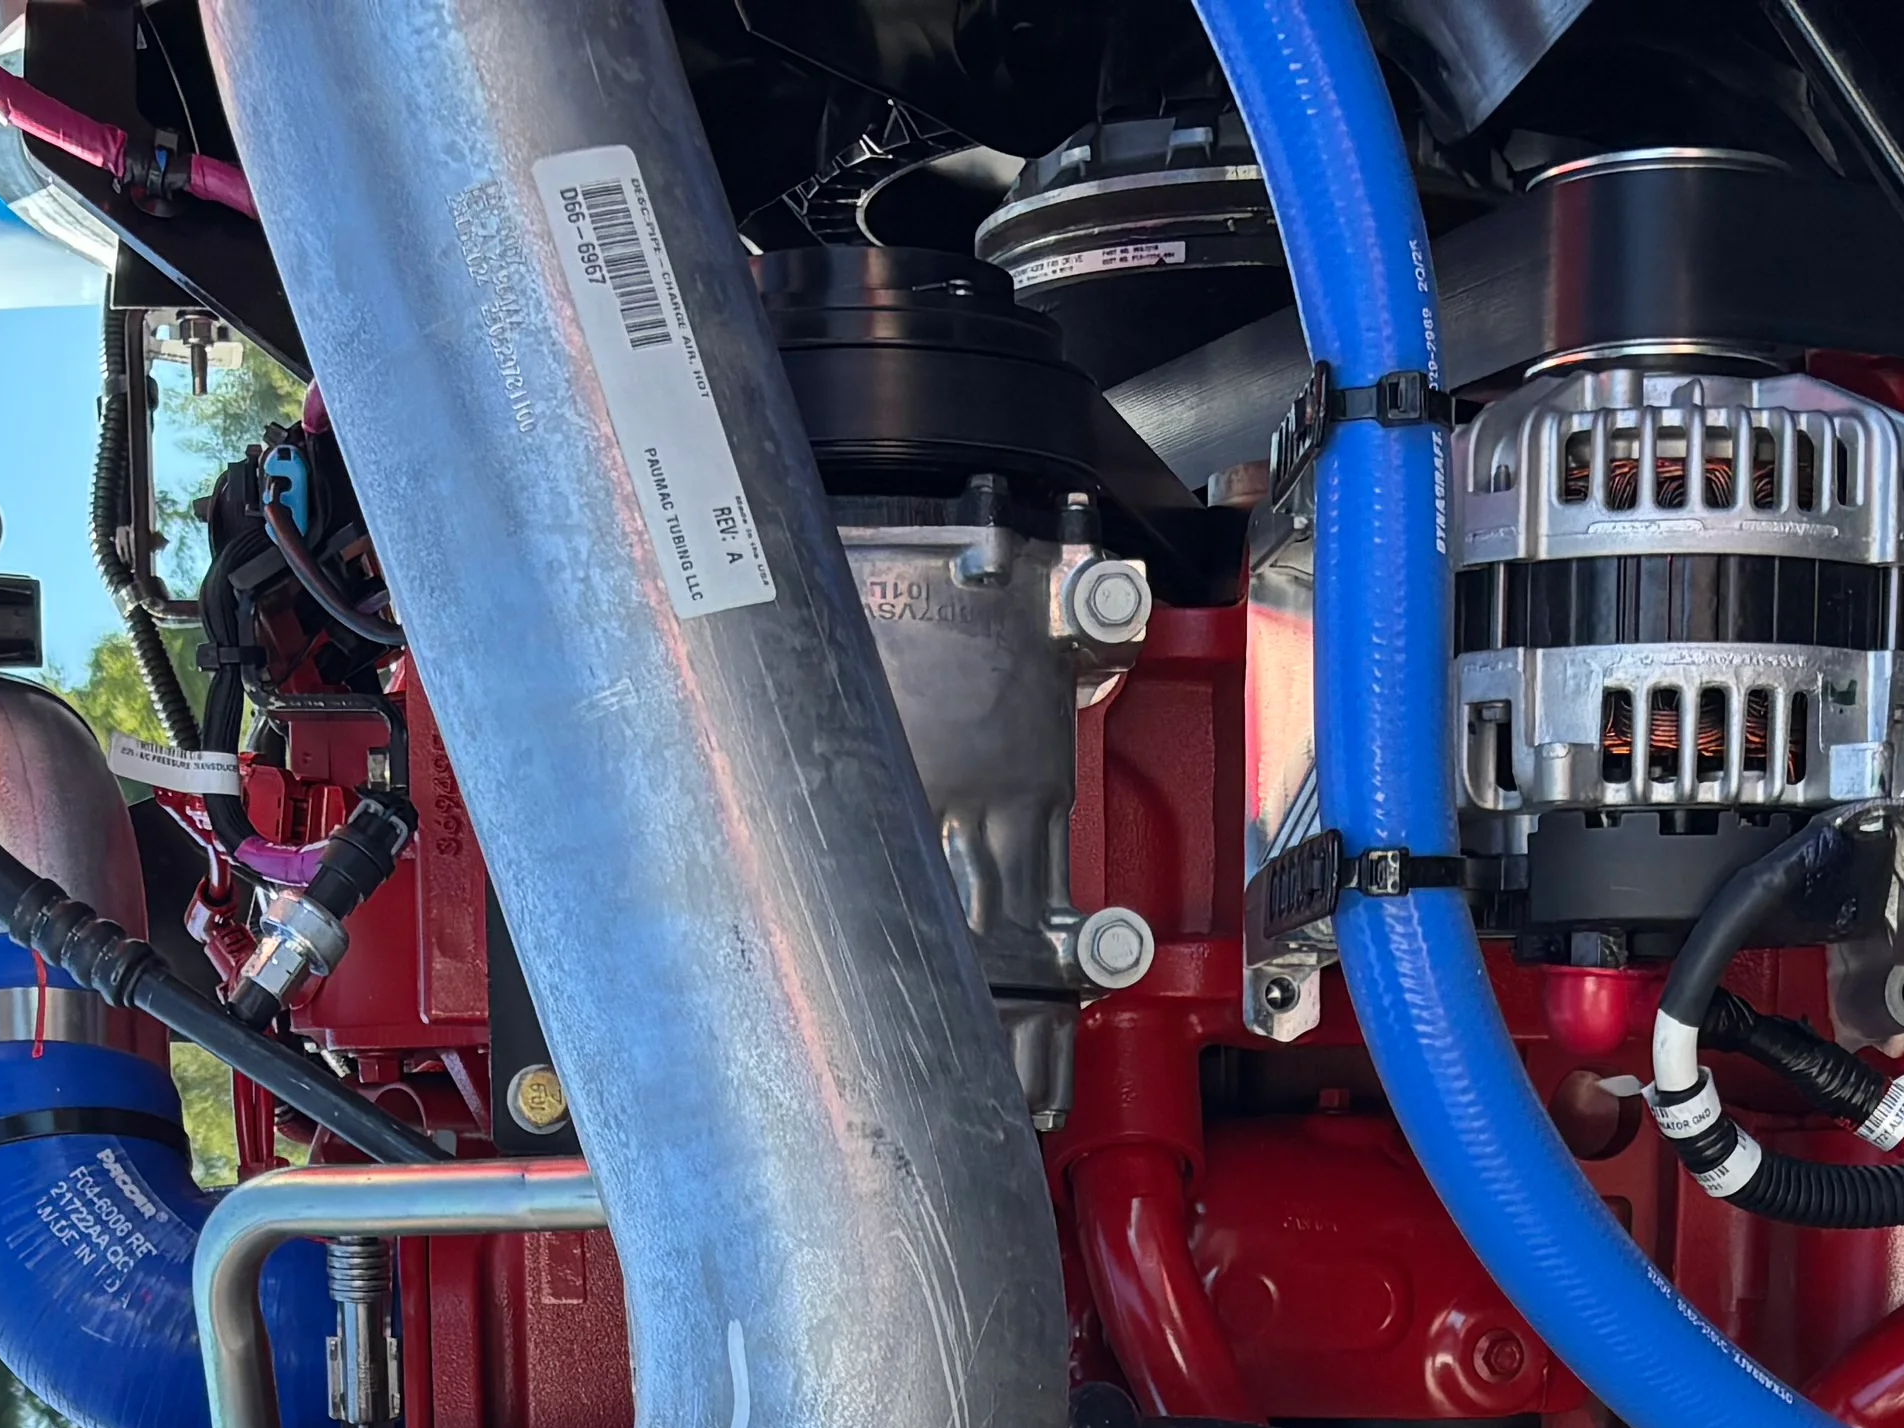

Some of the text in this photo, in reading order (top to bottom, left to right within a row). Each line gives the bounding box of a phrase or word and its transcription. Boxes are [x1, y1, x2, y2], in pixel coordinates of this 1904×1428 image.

[659, 270, 688, 330] CHARGE
[691, 368, 710, 400] HOT
[642, 446, 705, 602] PAUMAC TUBING LLC
[710, 504, 744, 565] REV: A
[49, 1178, 113, 1256] 21722AA
[68, 1163, 133, 1242] F04-6006
